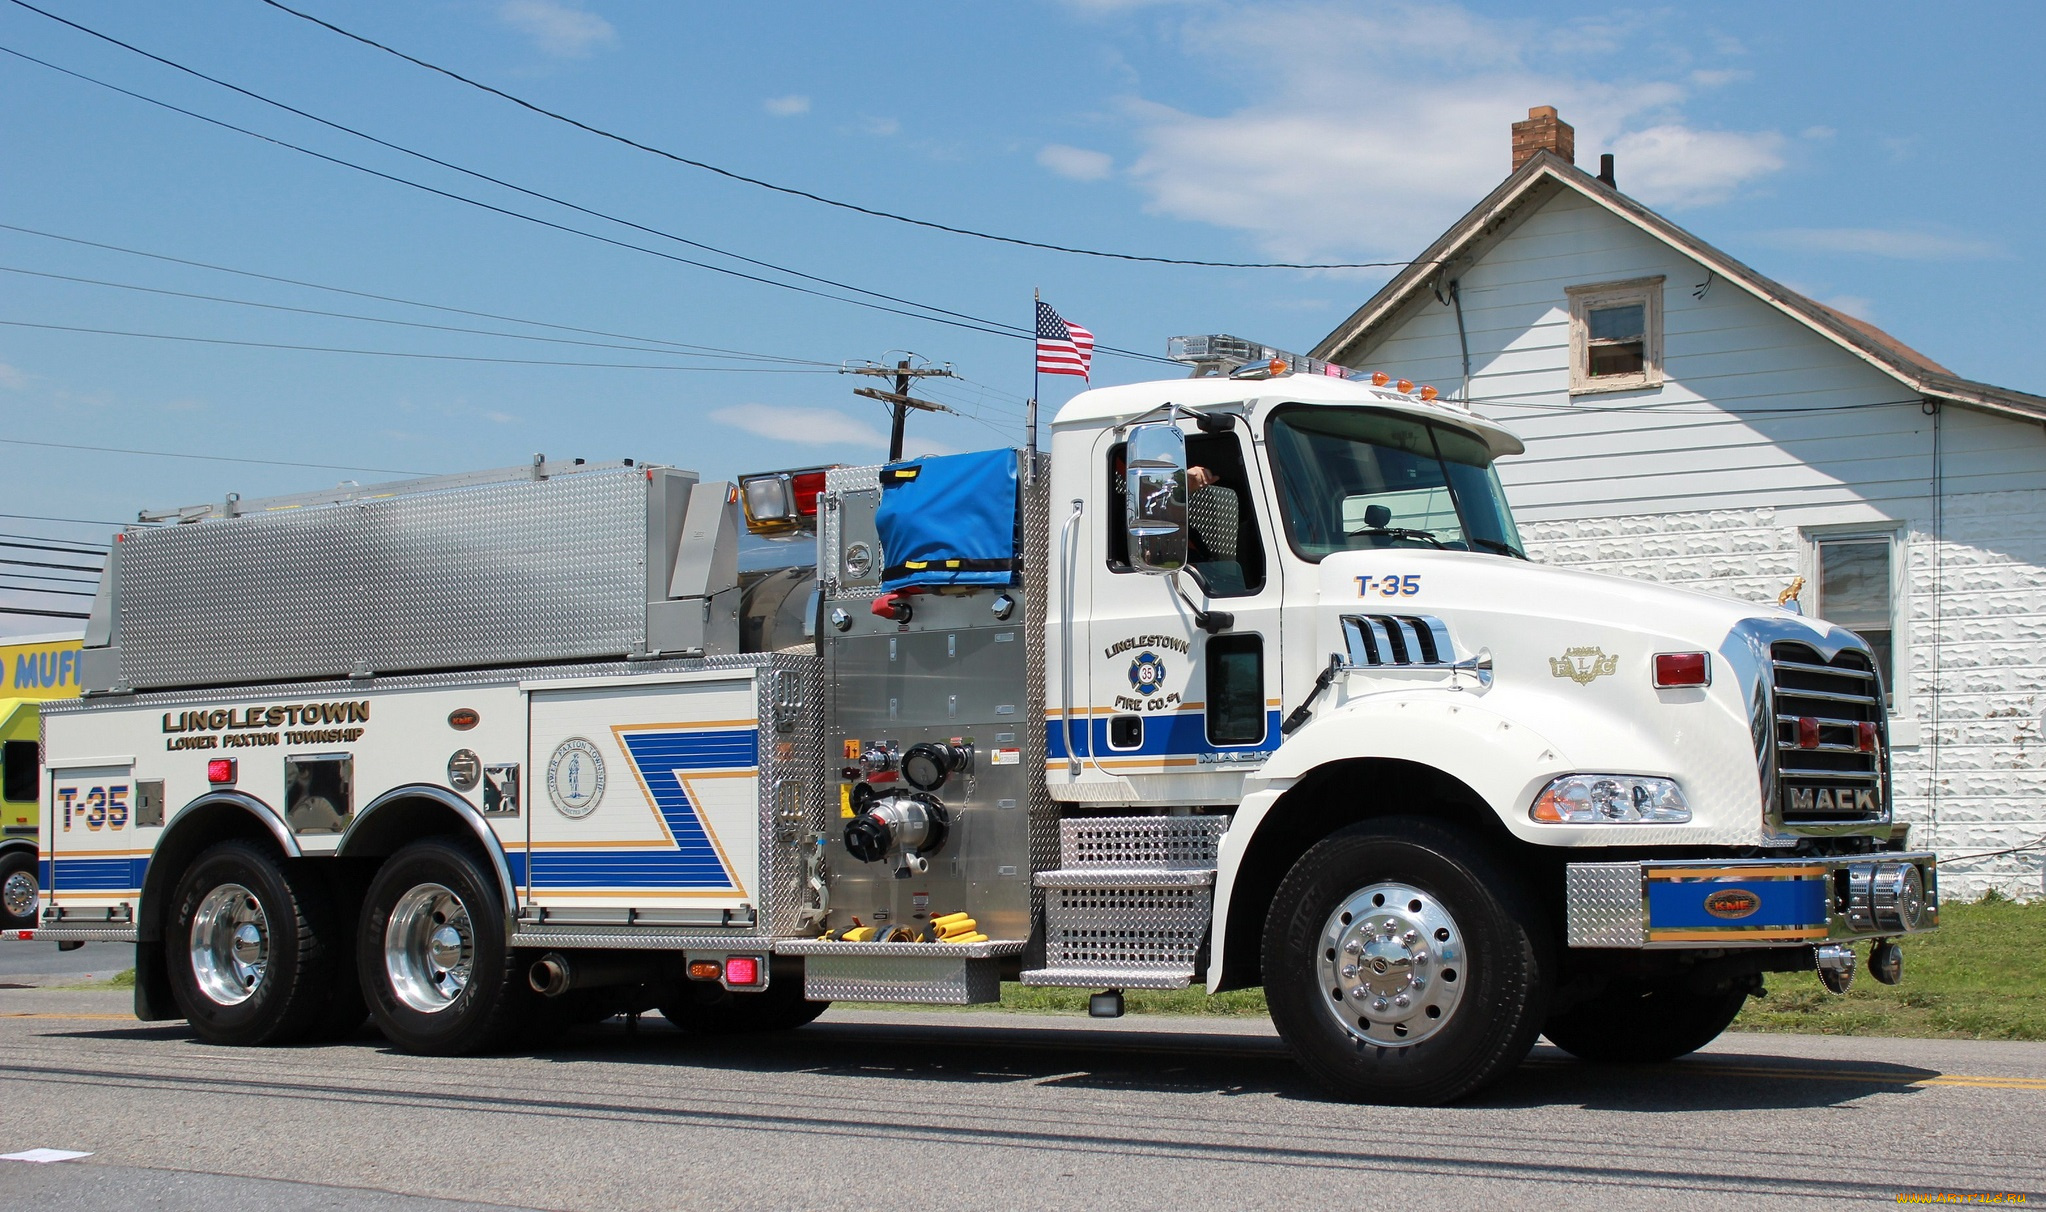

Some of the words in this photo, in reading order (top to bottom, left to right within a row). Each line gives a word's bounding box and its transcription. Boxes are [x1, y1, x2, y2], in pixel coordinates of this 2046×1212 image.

[1353, 575, 1421, 598] T-35
[1105, 635, 1190, 659] LINGLESTOWN
[1142, 667, 1153, 680] 35
[1115, 695, 1142, 711] FIRE
[163, 701, 370, 733] LINGLESTOWN
[167, 735, 218, 751] LOWER
[223, 732, 280, 748] PAXTON
[284, 727, 365, 746] TOWNSHIP
[558, 740, 587, 757] PAXTON
[589, 746, 604, 793] TOWNSHIP
[1199, 751, 1273, 763] MACK
[58, 785, 128, 832] T-35
[1790, 788, 1875, 809] MACK
[1715, 900, 1750, 911] KME
